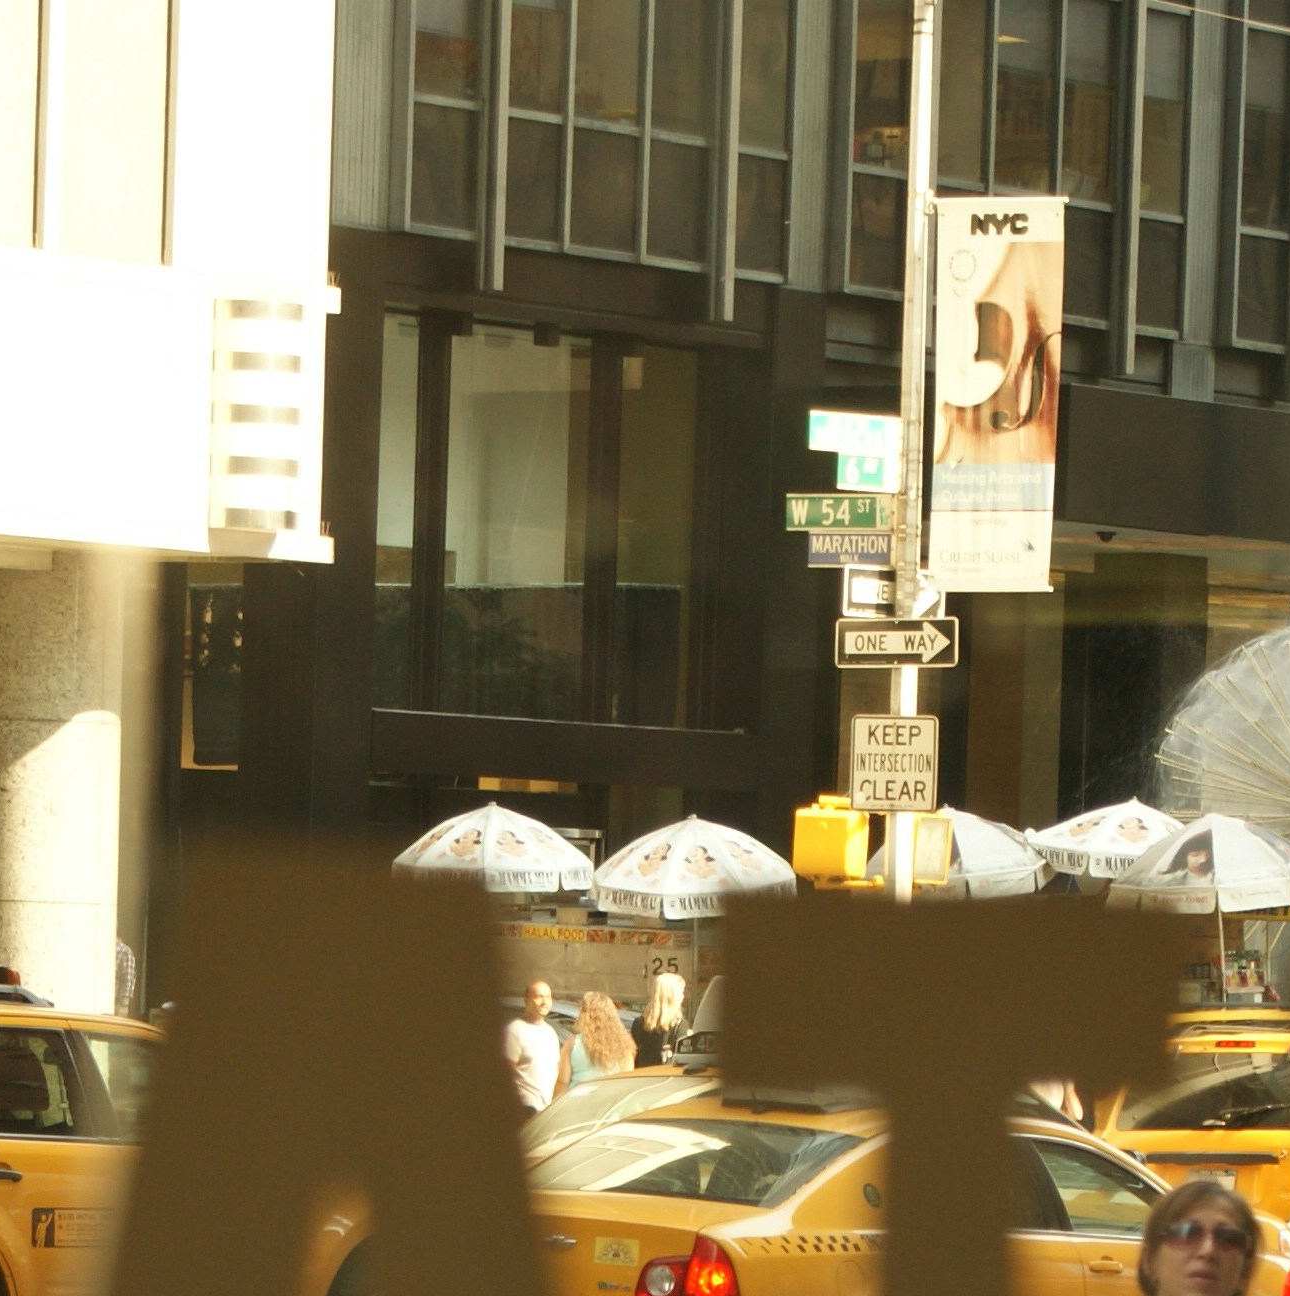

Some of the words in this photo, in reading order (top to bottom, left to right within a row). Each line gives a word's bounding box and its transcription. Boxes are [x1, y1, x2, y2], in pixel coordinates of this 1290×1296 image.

[970, 213, 1029, 236] NYC
[791, 499, 809, 526] W
[821, 499, 850, 526] 54
[857, 499, 871, 513] ST
[811, 535, 888, 554] MARATHON
[840, 554, 859, 563] WALK
[854, 634, 888, 651] ONE
[903, 634, 938, 651] WAY
[868, 725, 922, 746] KEEP
[856, 752, 933, 773] INTERSECTION
[859, 780, 927, 801] CLEAR
[524, 926, 553, 939] HALAL
[559, 928, 585, 940] FOOD
[652, 957, 680, 975] 25
